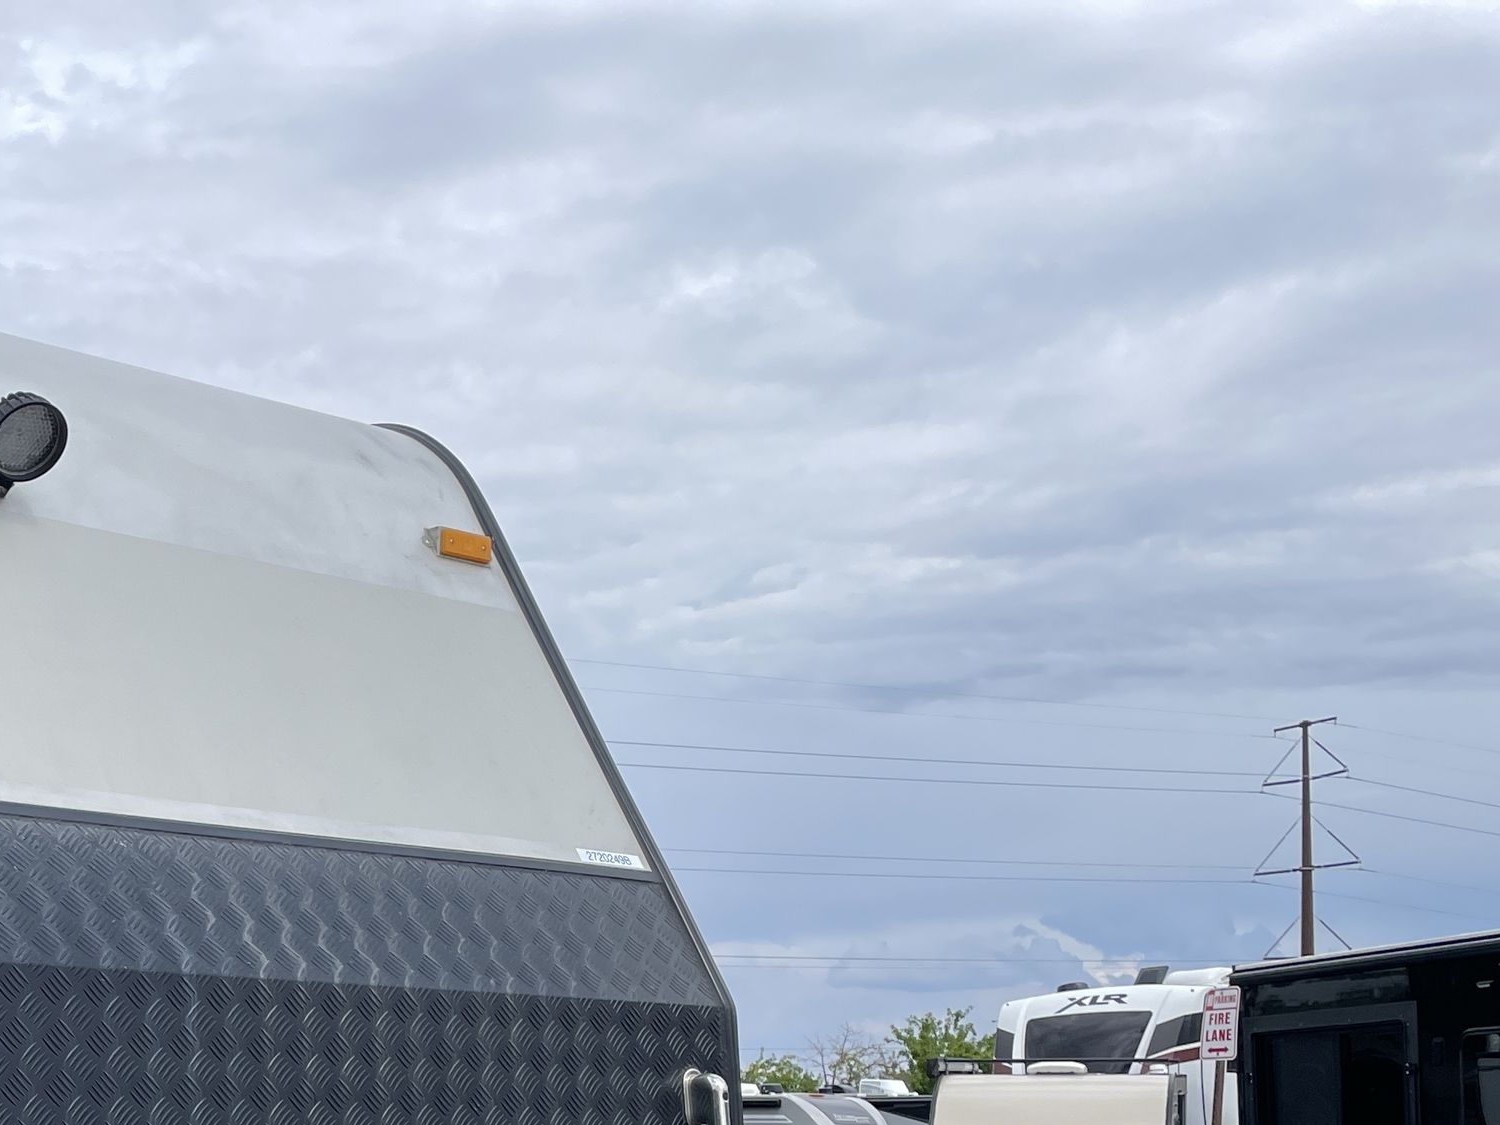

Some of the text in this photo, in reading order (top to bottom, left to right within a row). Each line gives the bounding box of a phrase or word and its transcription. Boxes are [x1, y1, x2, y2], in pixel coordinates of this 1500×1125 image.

[1056, 993, 1128, 1013] XLR
[1209, 1012, 1231, 1025] FIRE
[1206, 1029, 1232, 1042] LANE
